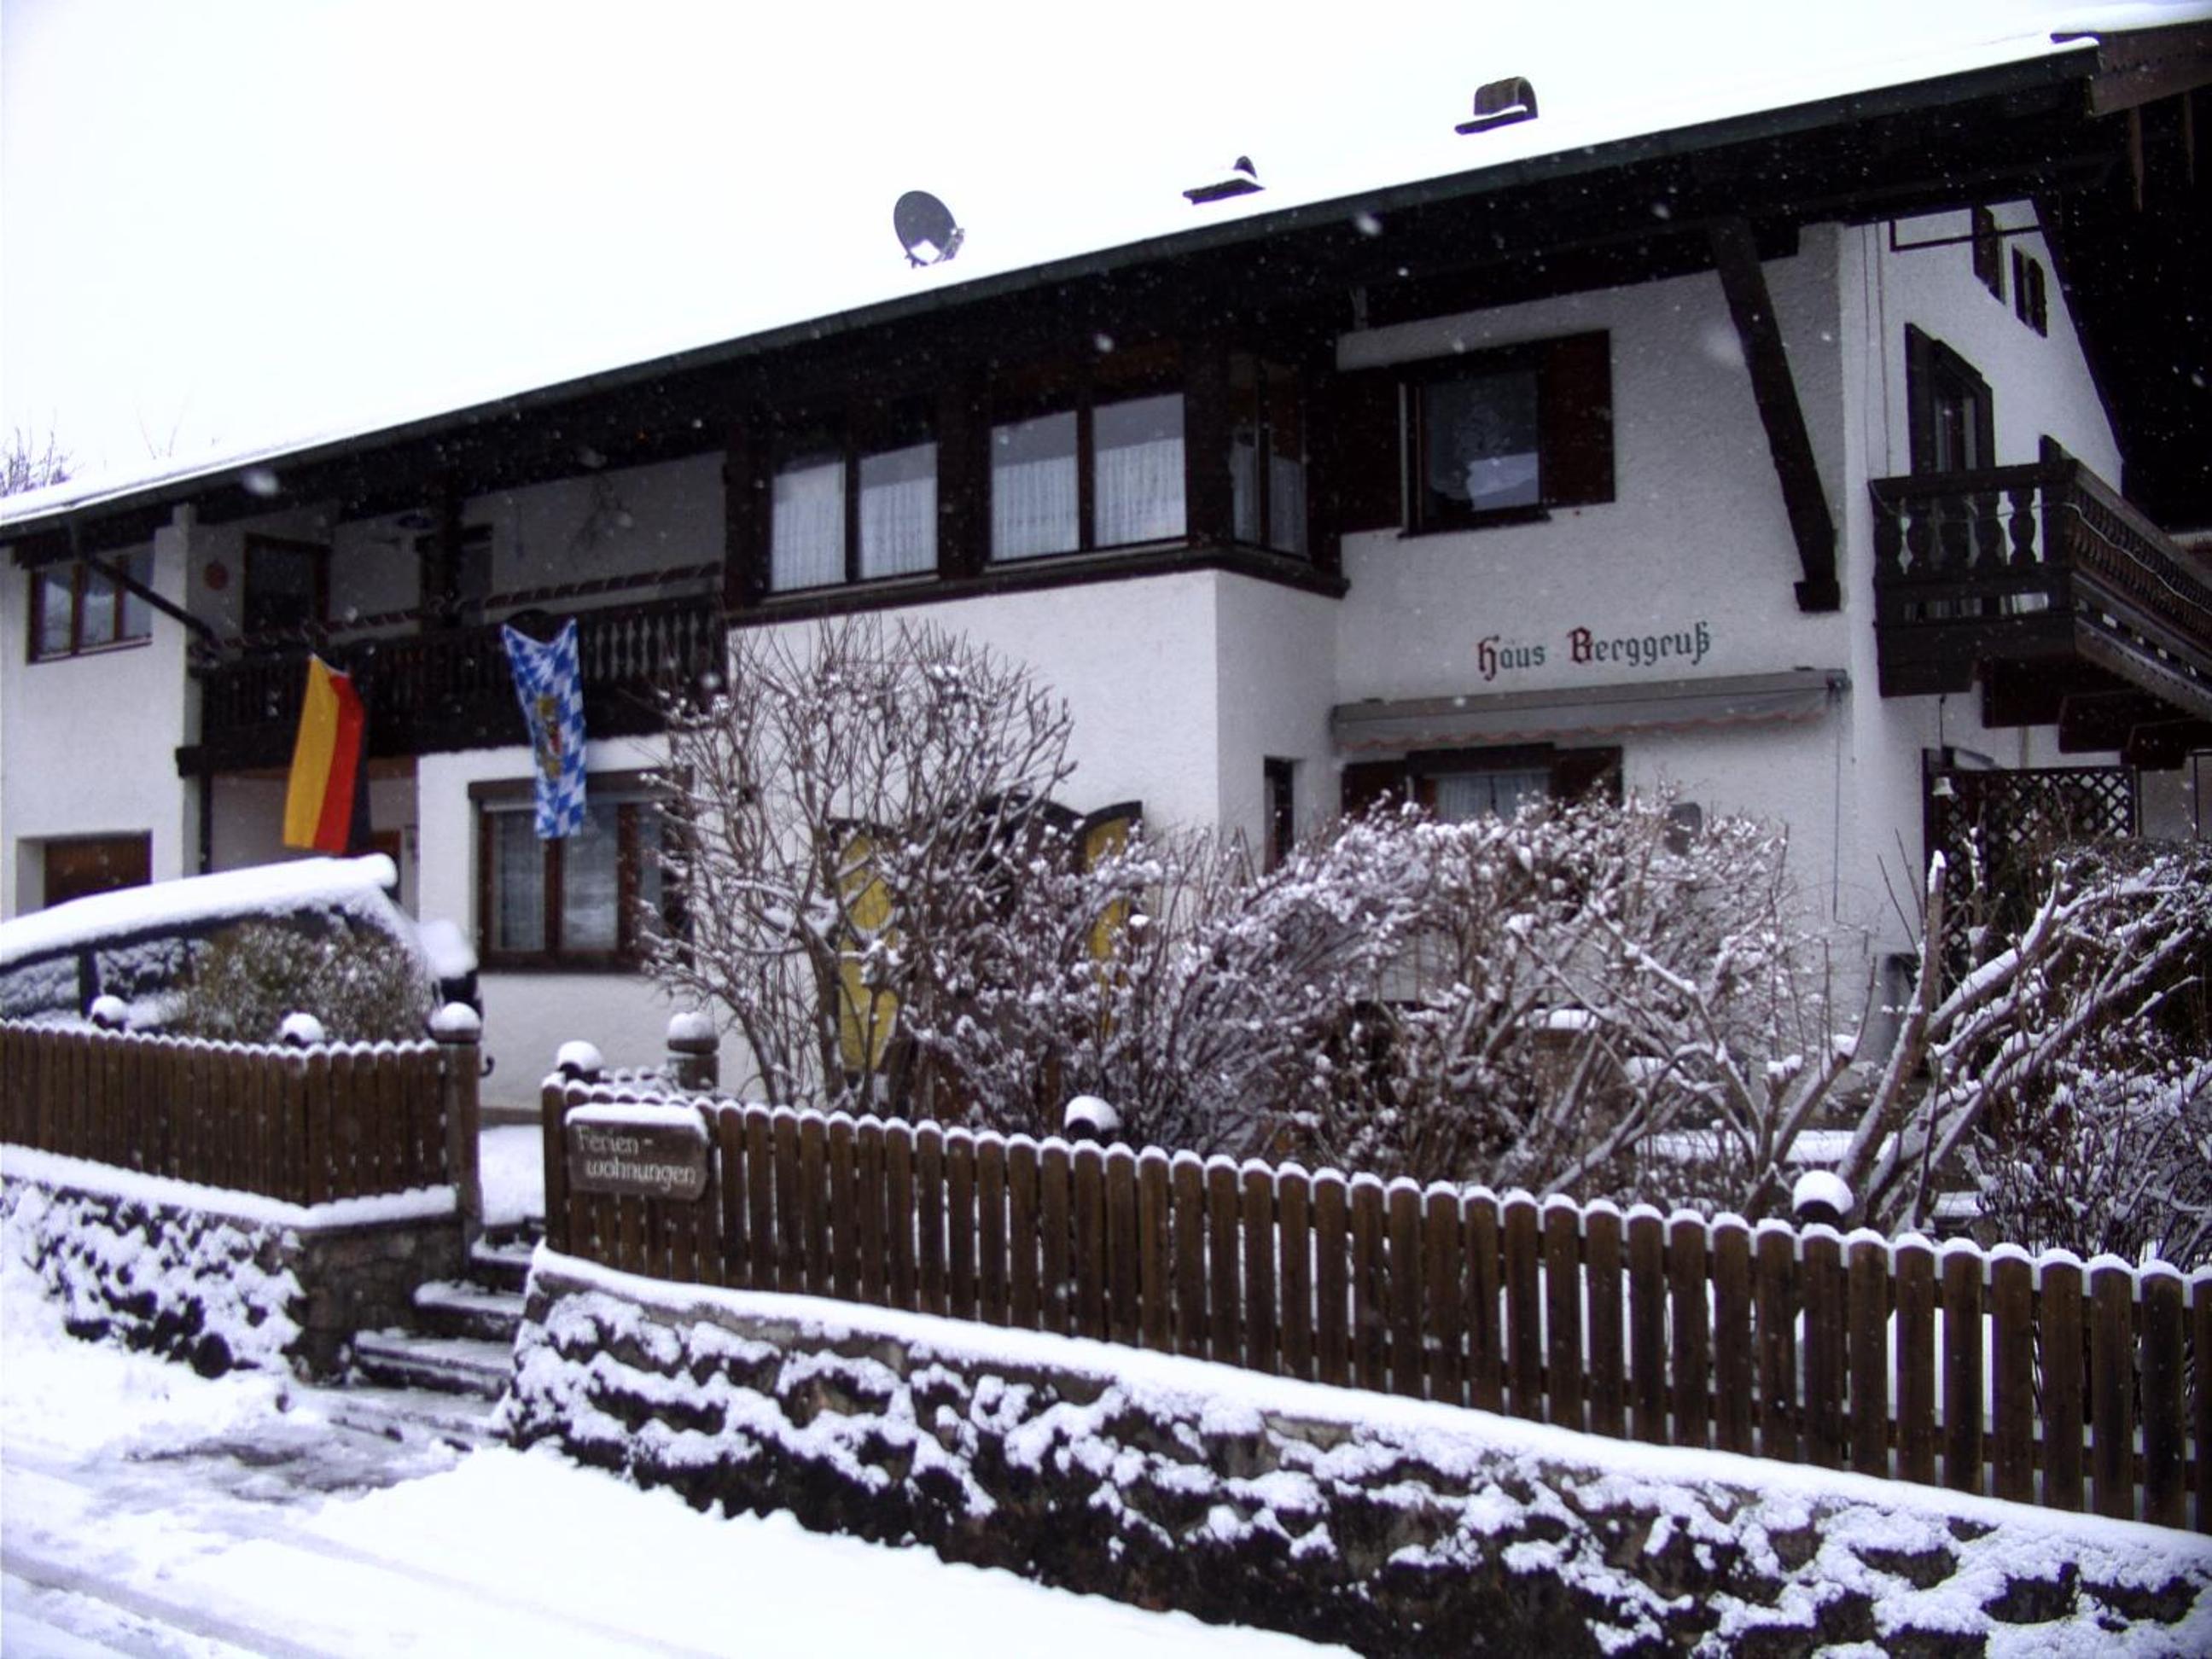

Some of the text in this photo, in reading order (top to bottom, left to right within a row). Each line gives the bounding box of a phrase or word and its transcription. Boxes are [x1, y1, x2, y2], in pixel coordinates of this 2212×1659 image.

[1477, 620, 1711, 681] Haus Berggruß
[586, 1155, 696, 1191] wohnungen
